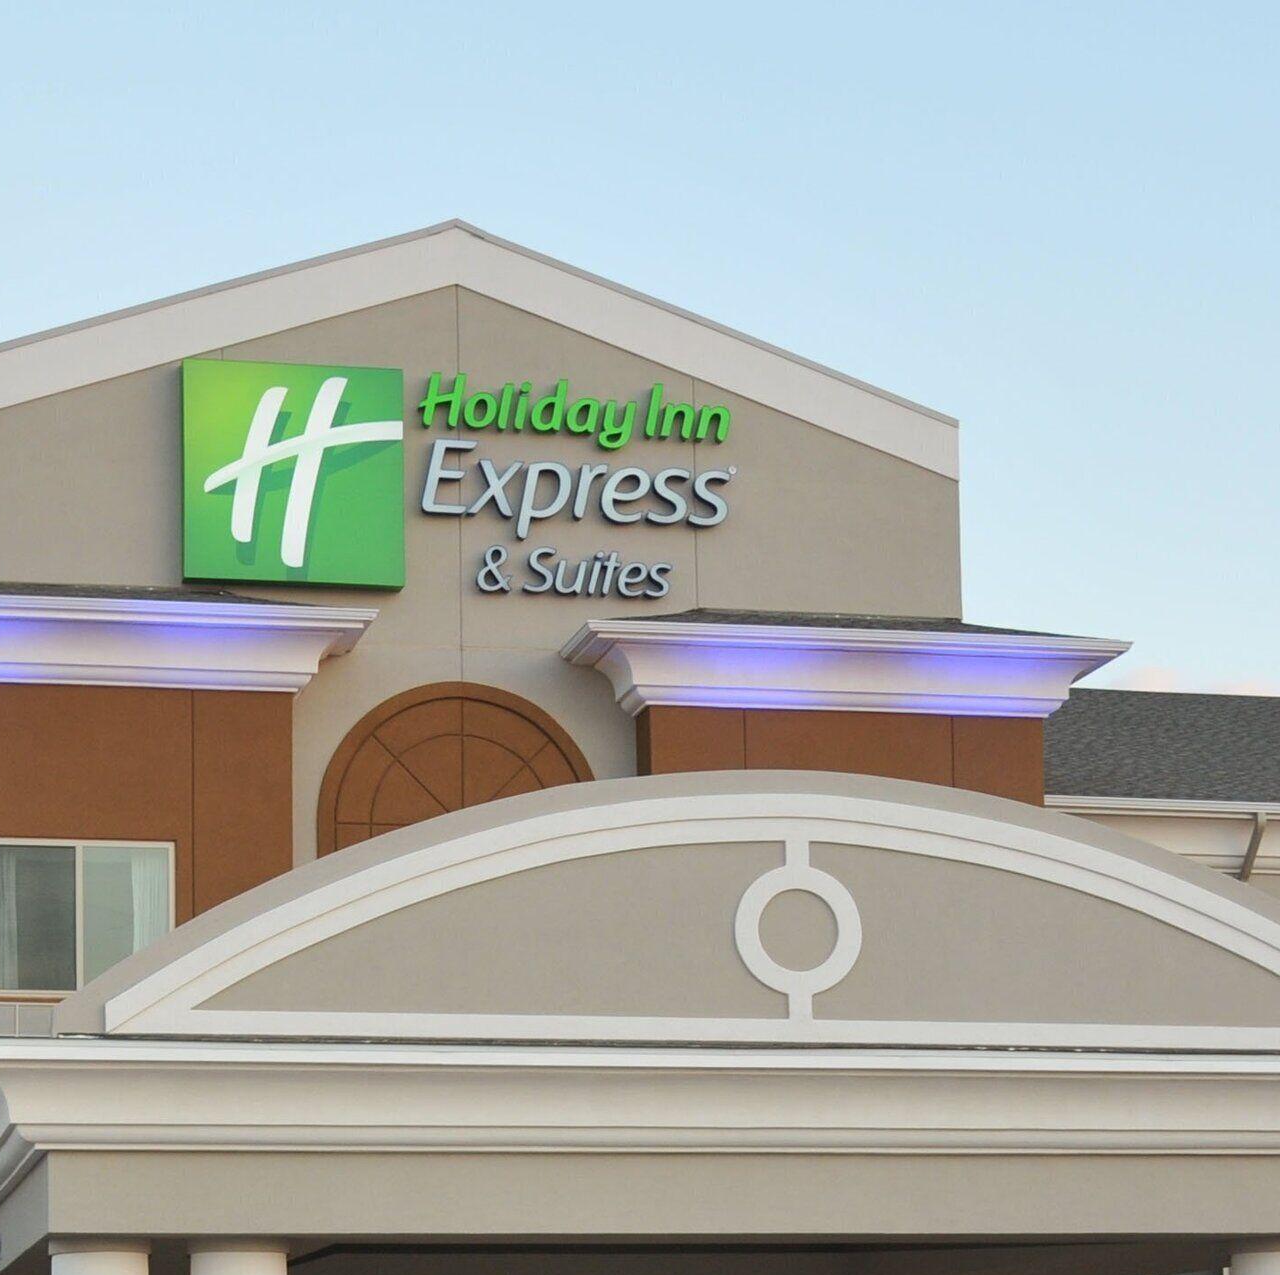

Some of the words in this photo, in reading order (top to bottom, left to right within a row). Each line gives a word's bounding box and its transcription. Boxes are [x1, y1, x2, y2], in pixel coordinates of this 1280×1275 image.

[418, 372, 637, 450] Holiday
[644, 382, 731, 443] Inn
[204, 375, 403, 568] H
[421, 439, 731, 541] Express
[476, 544, 513, 593] &
[522, 546, 672, 599] Suites
